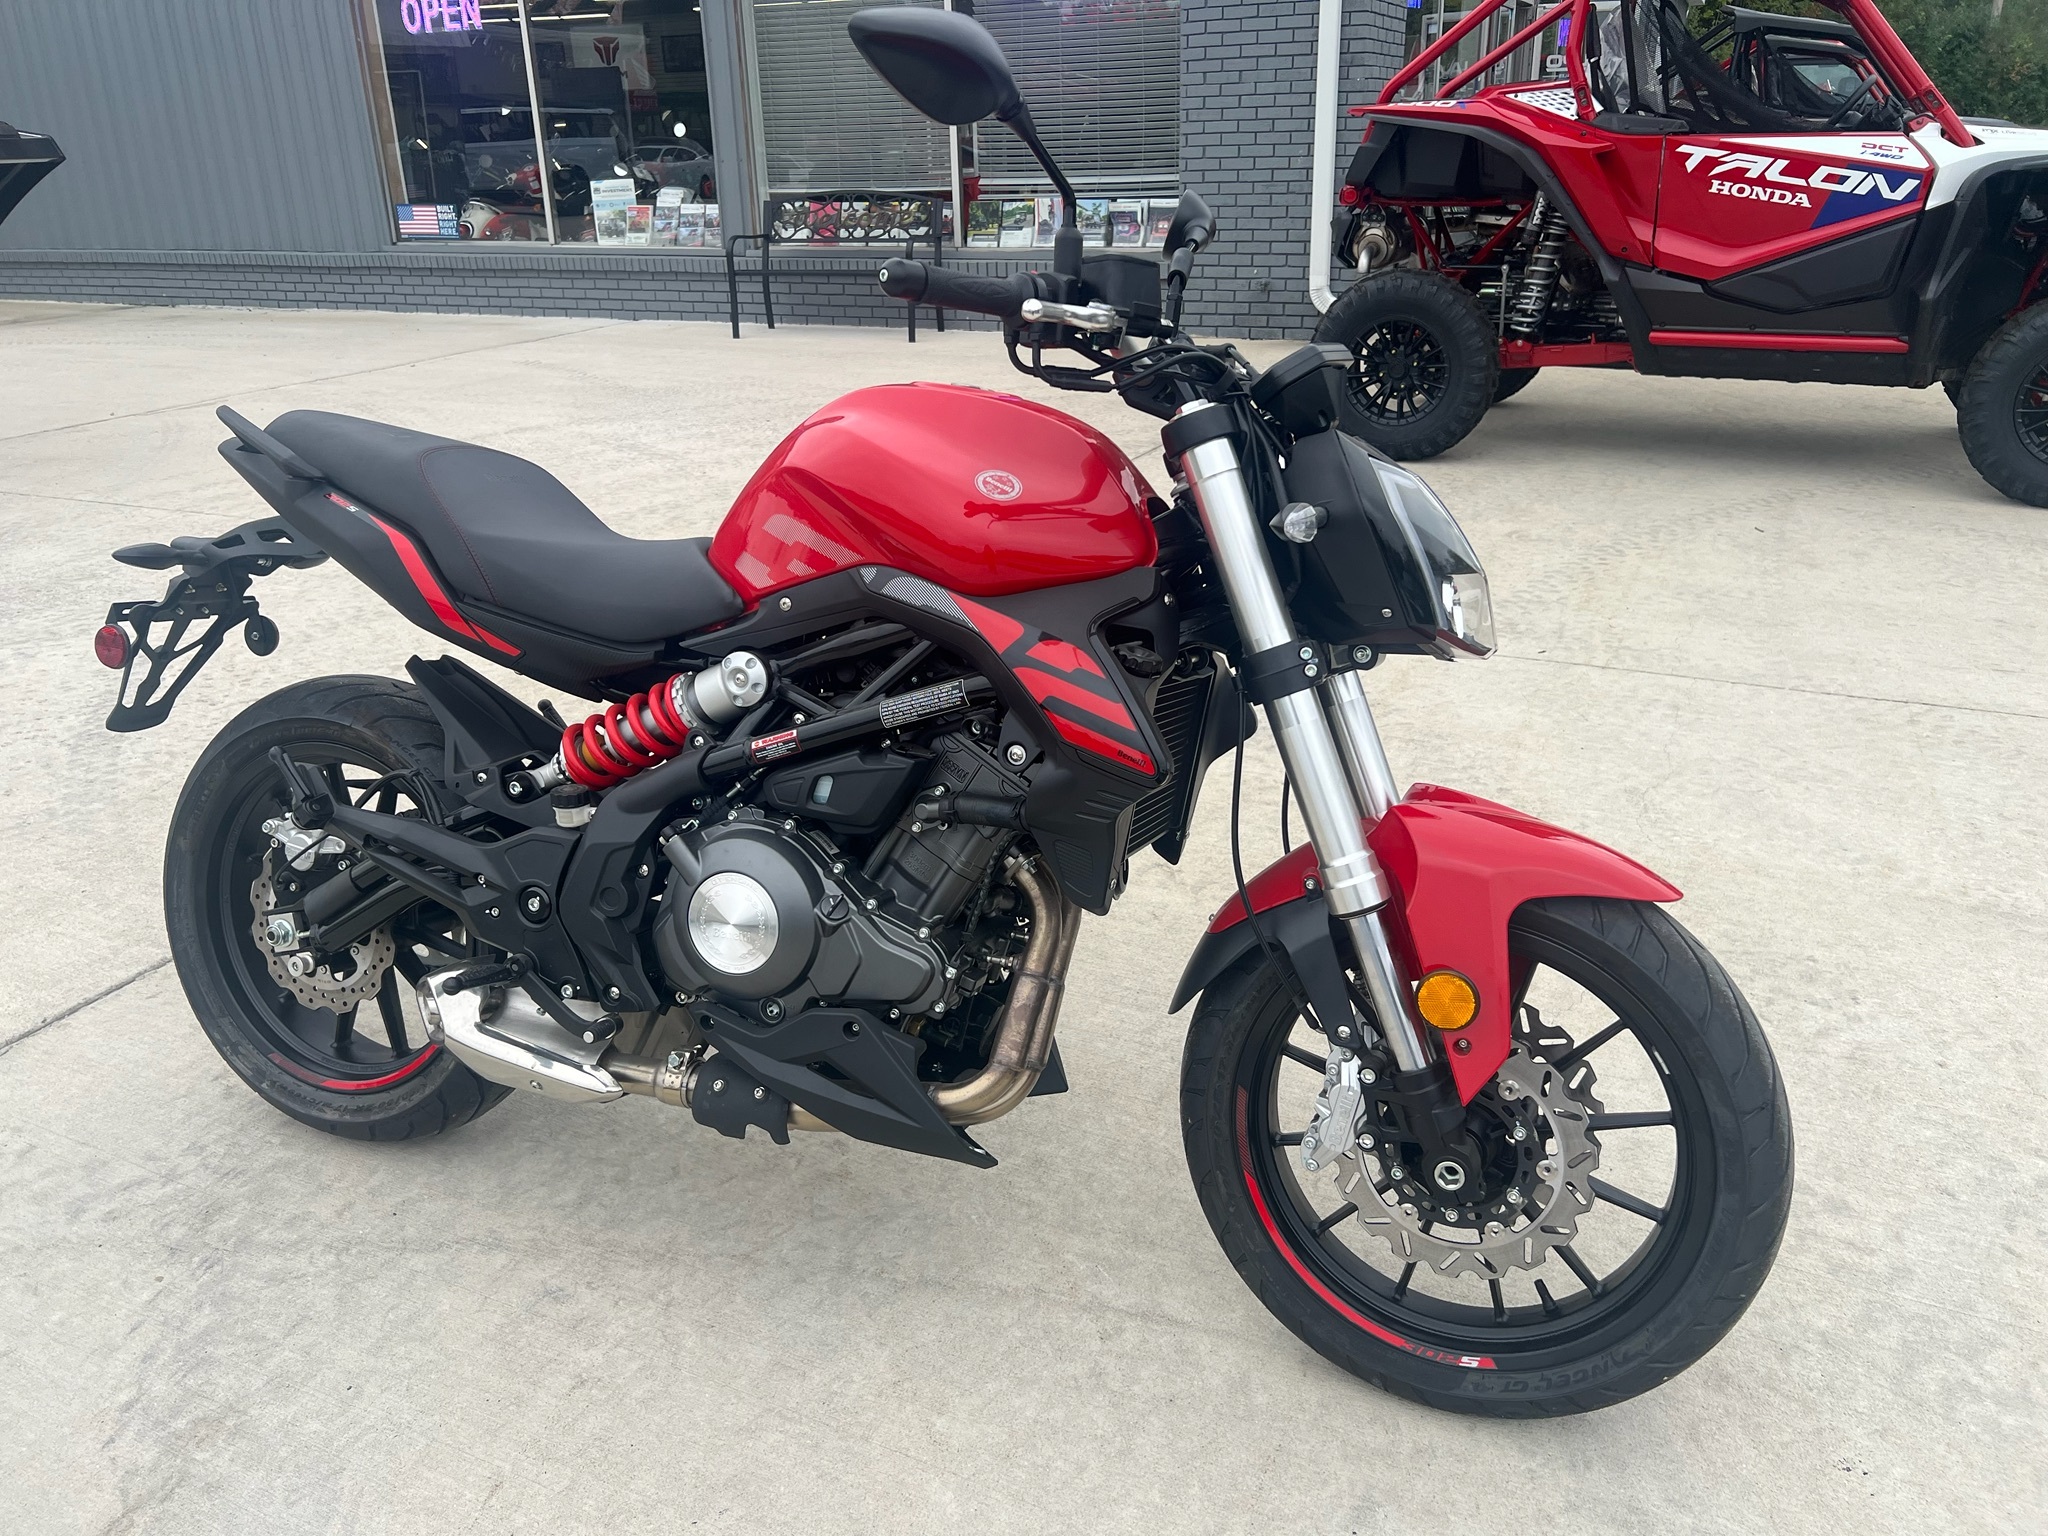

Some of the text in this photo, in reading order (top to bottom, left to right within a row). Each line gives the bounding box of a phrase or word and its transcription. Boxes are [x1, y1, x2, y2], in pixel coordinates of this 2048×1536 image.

[400, 0, 483, 34] OPEN
[1861, 142, 1909, 153] DCT
[1675, 144, 1921, 200] TALON
[1708, 179, 1813, 208] HONDA
[436, 204, 454, 213] BUILT
[437, 212, 458, 220] RIGHT.
[439, 220, 457, 228] RIGHT
[1117, 749, 1147, 768] Benelli
